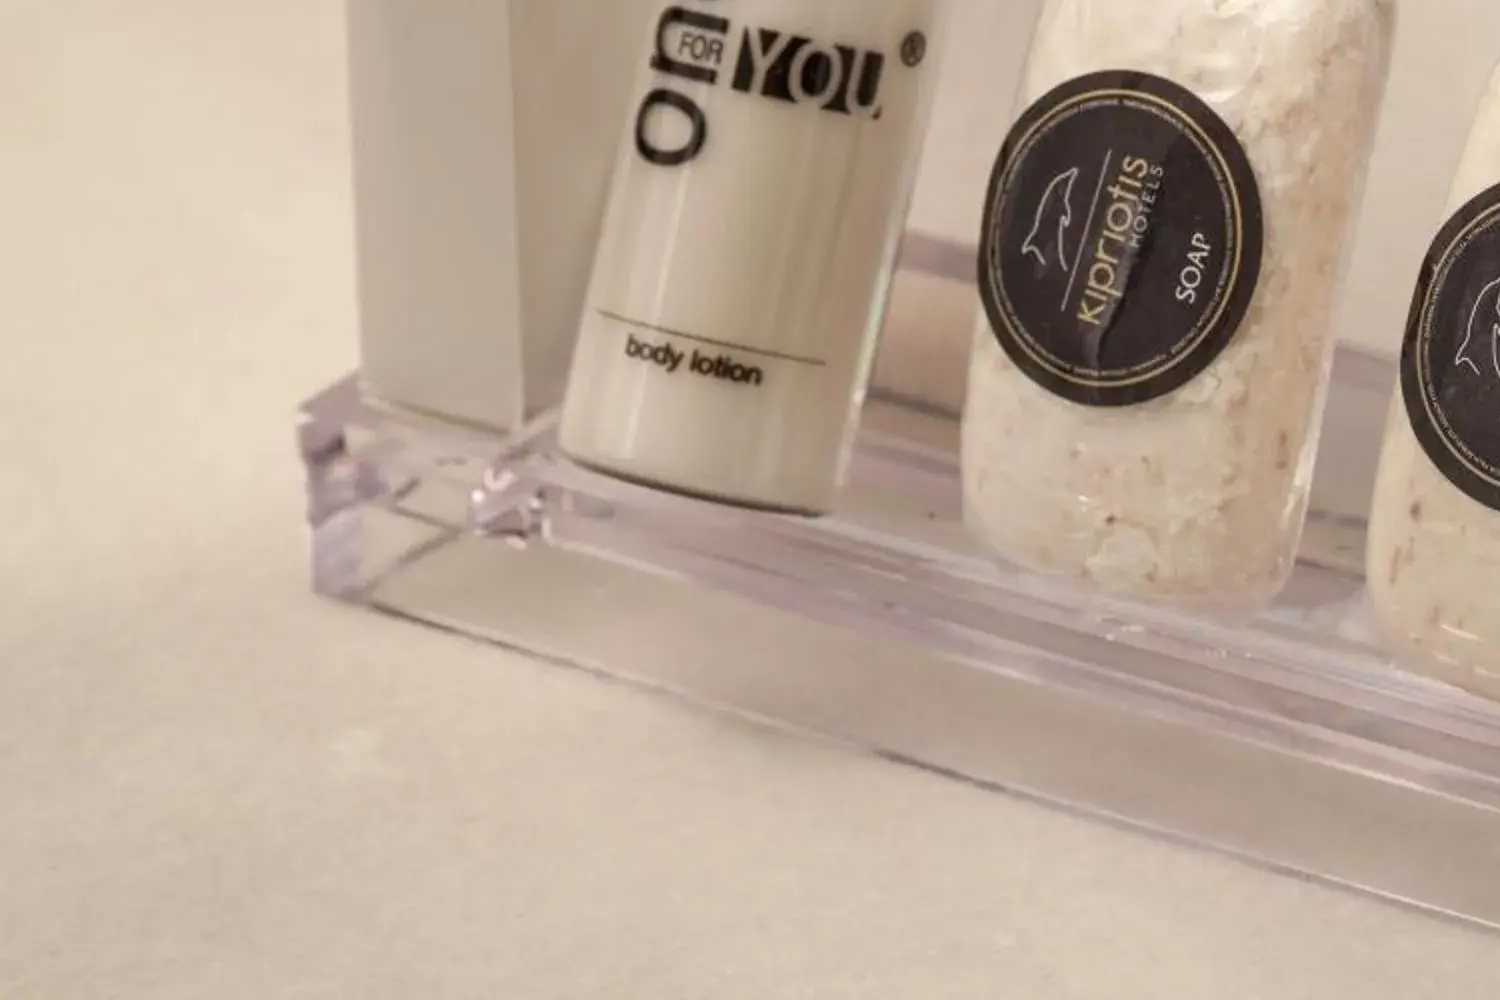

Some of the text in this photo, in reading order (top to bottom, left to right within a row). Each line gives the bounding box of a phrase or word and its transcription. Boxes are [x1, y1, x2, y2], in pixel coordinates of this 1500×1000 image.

[678, 31, 725, 66] FOR
[1129, 165, 1164, 248] HOTELS
[1176, 232, 1212, 304] SOAP
[625, 333, 763, 386] body lotion
